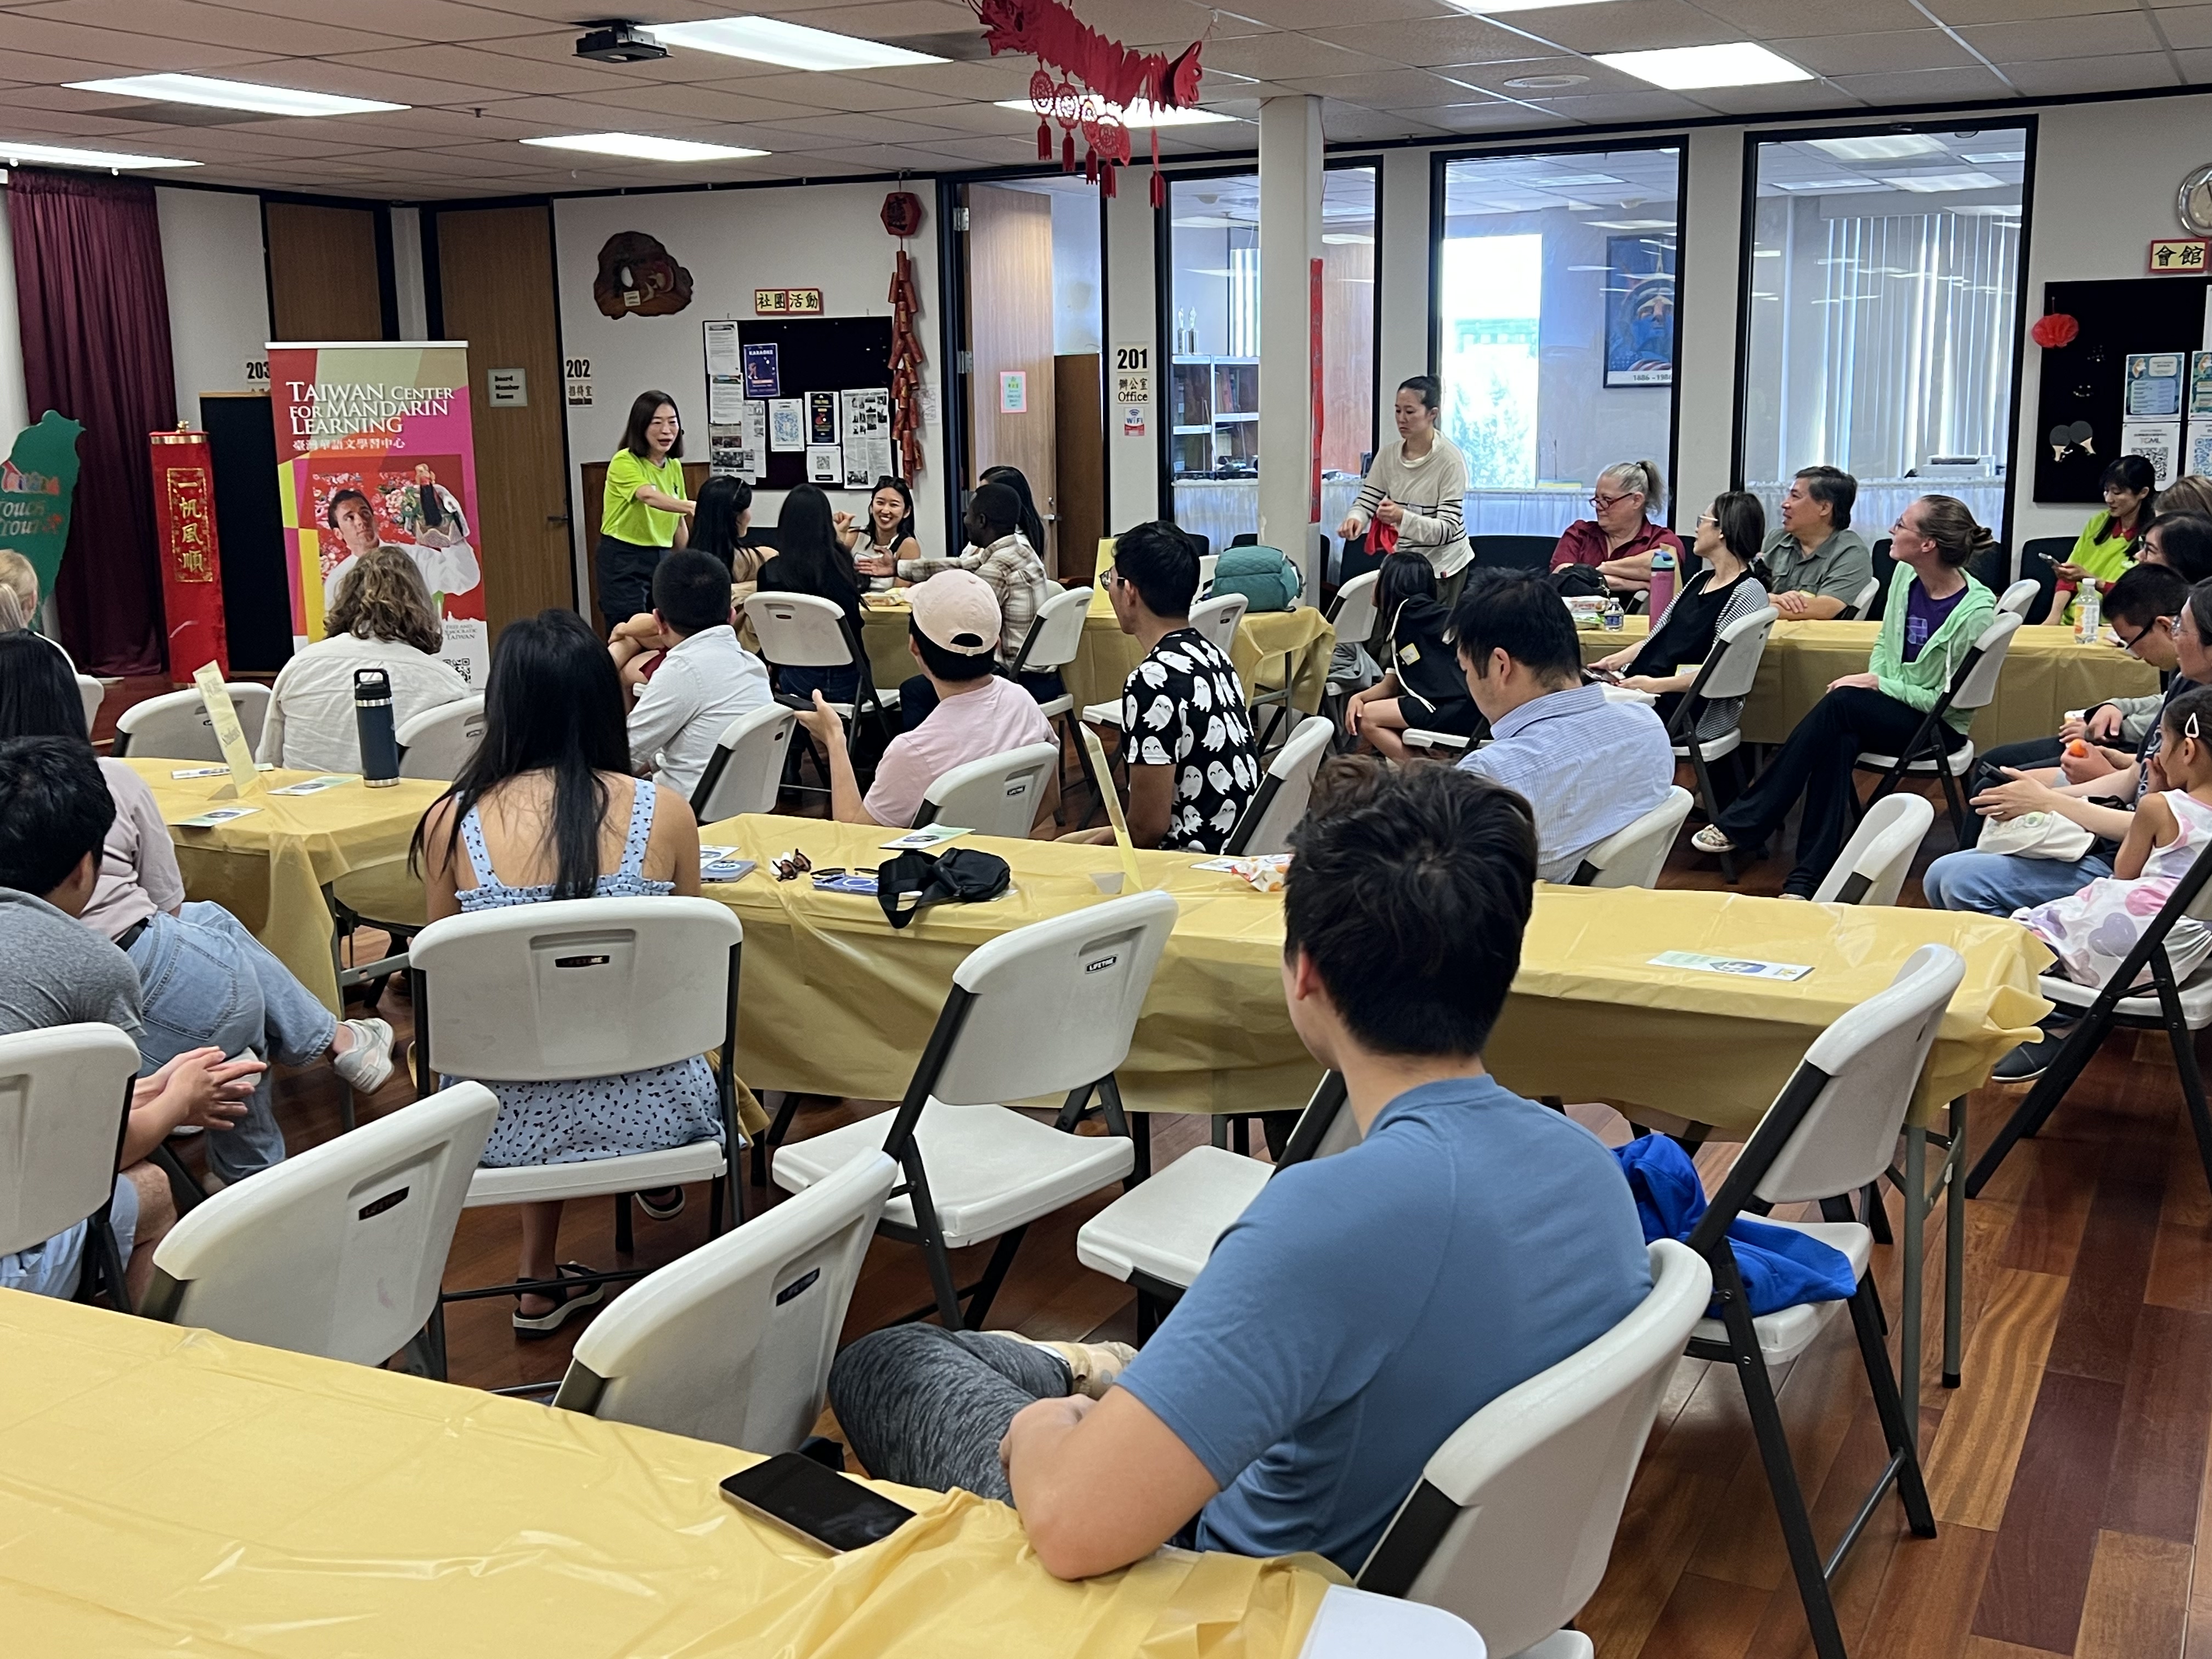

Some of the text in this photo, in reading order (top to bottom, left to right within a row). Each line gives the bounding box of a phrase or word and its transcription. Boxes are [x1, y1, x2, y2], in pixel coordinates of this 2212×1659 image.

[2154, 245, 2205, 267] 會館
[757, 292, 818, 309] 社團活動
[1117, 348, 1147, 369] 201
[247, 362, 270, 379] 203
[566, 359, 591, 378] 202
[286, 381, 455, 402] TAIWAN CENTER
[1119, 377, 1148, 391] 辦公室
[1118, 392, 1148, 402] Office
[289, 399, 448, 419] FOR MANDARIN
[292, 417, 403, 435] LEARNING
[0, 500, 46, 517] ouch
[178, 482, 204, 572] 一帆風順
